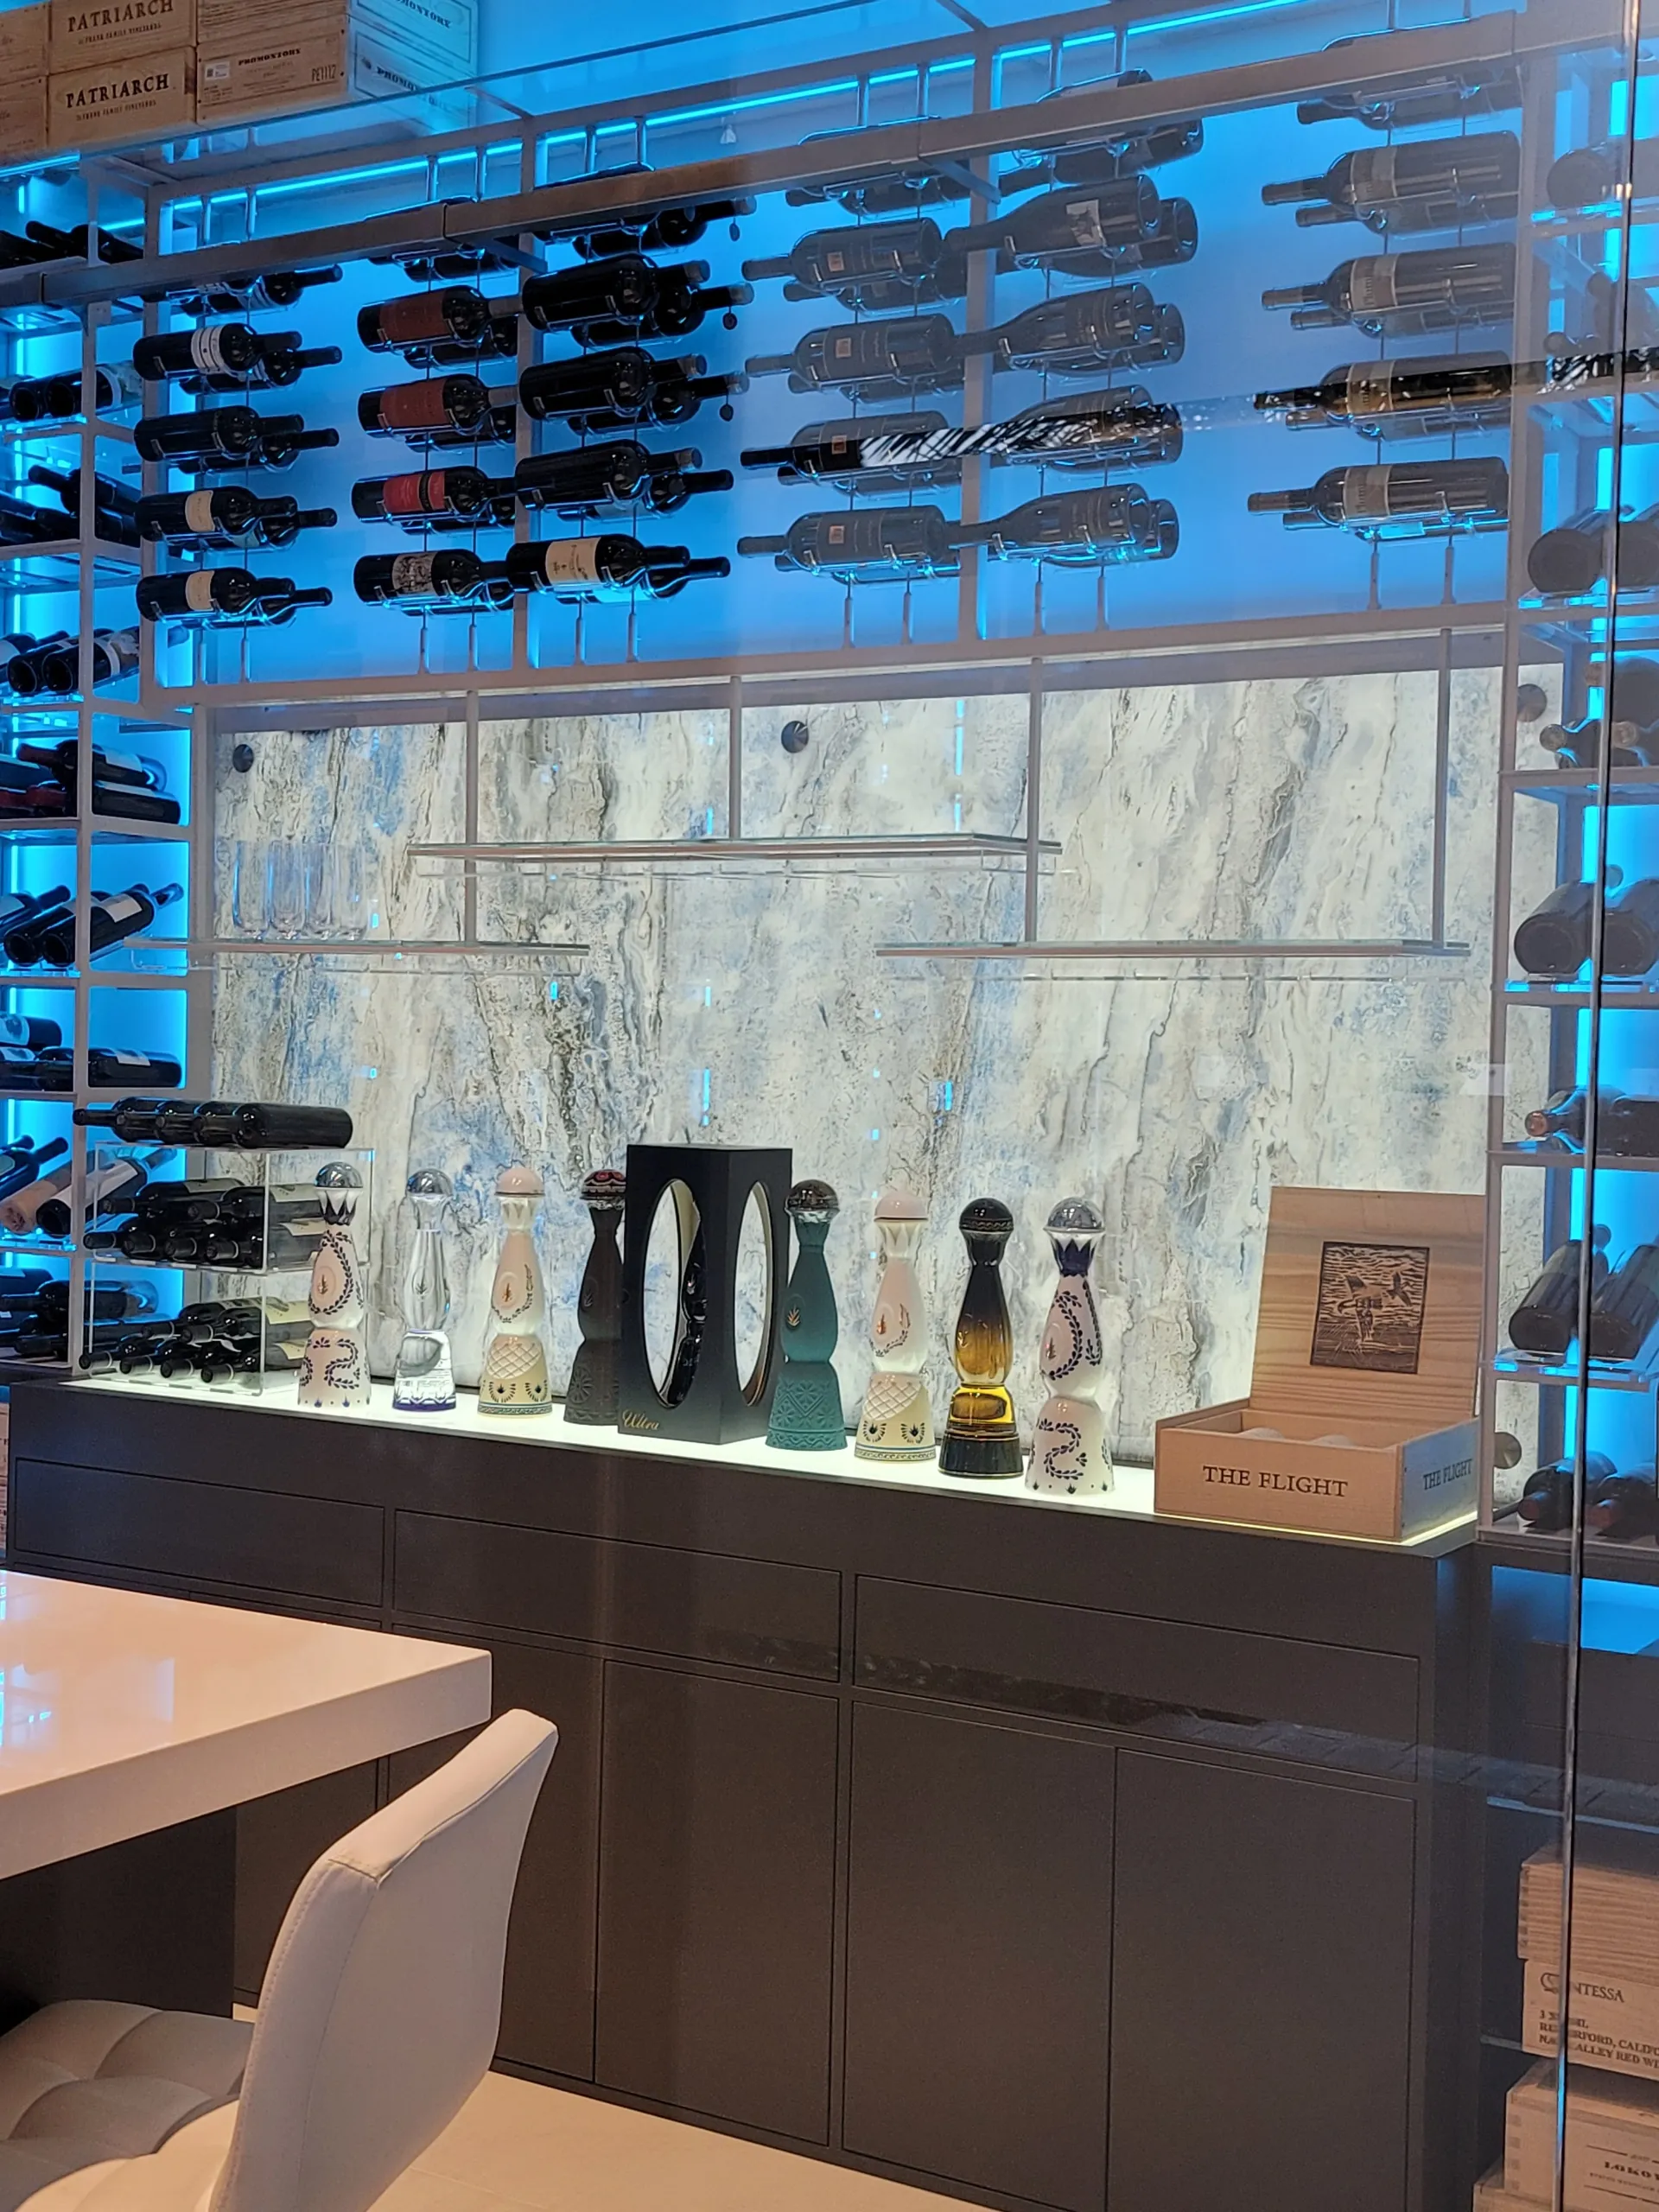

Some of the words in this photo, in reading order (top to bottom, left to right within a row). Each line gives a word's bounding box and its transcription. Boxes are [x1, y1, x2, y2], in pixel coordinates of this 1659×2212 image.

[67, 0, 173, 33] PATRIARCH
[66, 73, 169, 108] PATRIARCH
[1203, 1465, 1250, 1486] THE
[1258, 1471, 1349, 1497] FLIGHT
[1423, 1470, 1441, 1491] THE
[1443, 1458, 1472, 1484] FLIGHT
[1616, 2051, 1640, 2064] RED
